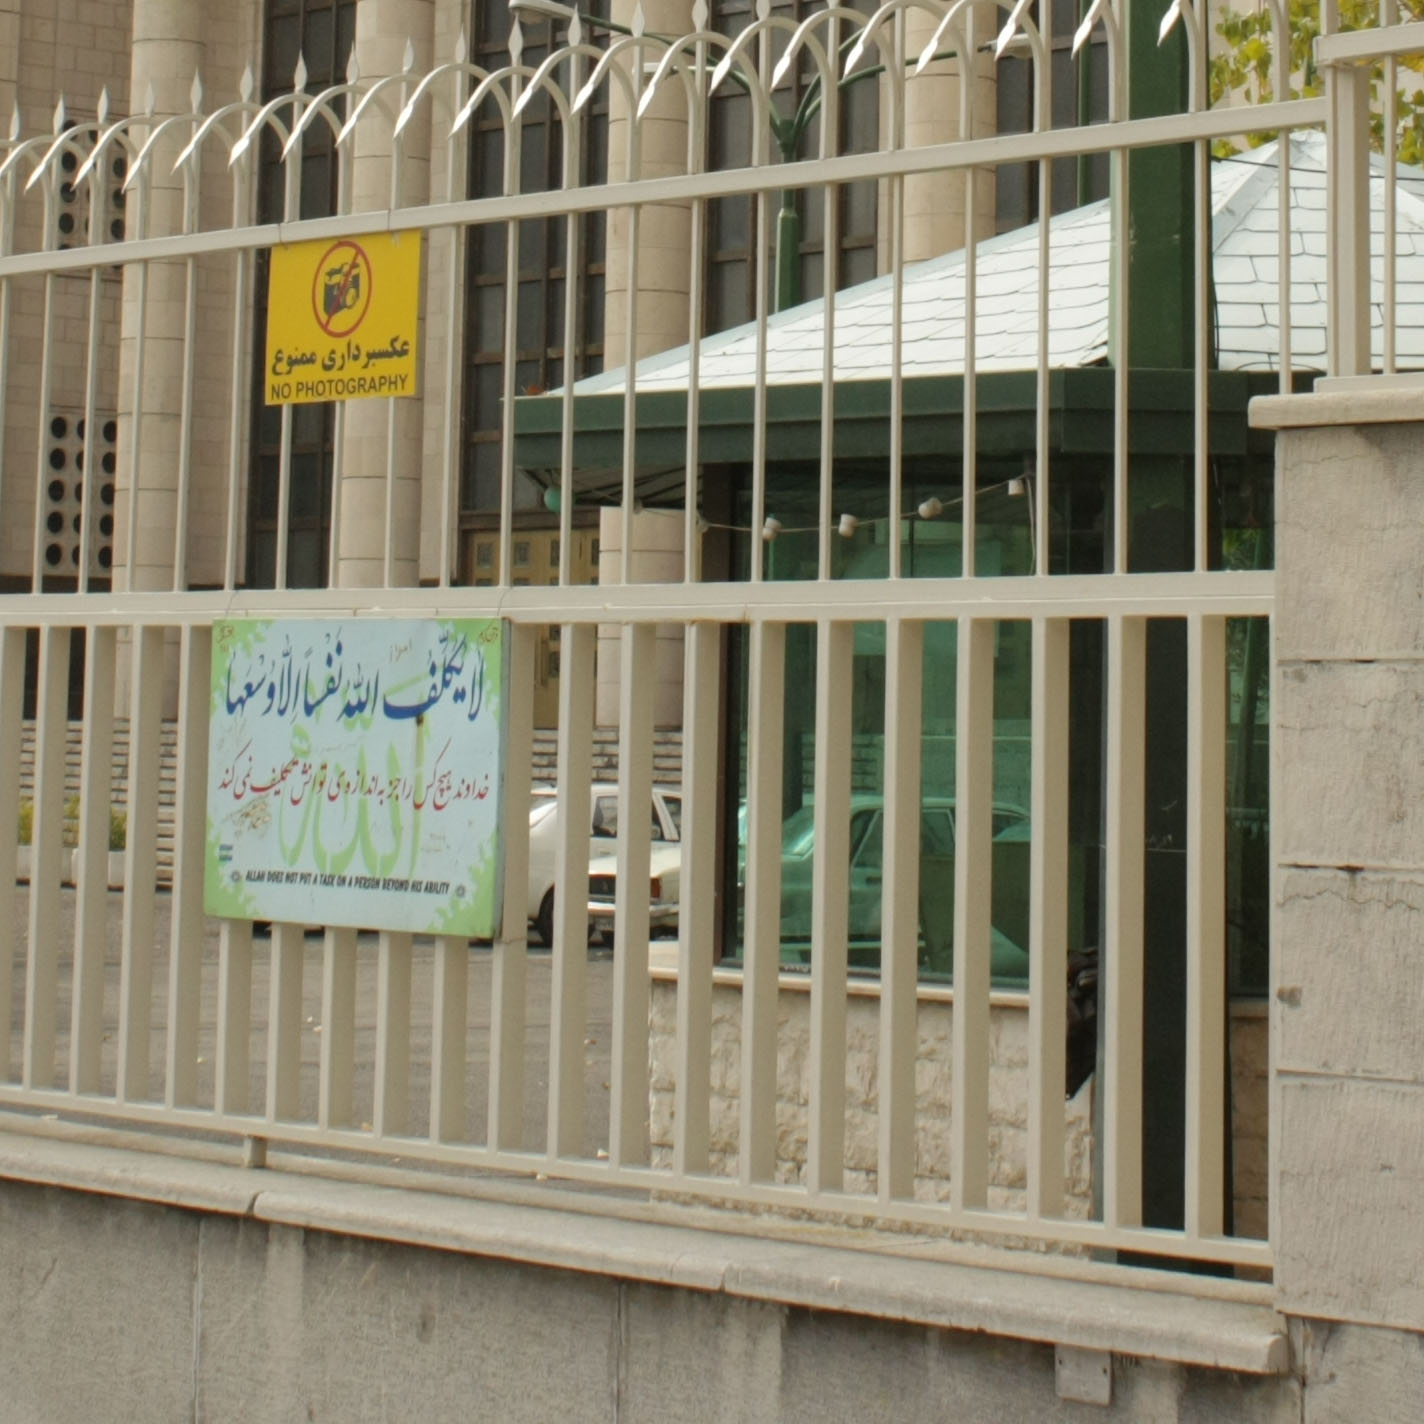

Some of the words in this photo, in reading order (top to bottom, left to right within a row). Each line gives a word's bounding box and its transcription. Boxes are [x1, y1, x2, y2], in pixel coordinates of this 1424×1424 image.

[271, 346, 317, 375] ممنوع
[271, 383, 292, 401] NO
[295, 374, 409, 399] PHOTOGRAPHY
[249, 755, 299, 796] تکلیف
[290, 760, 327, 806] توانش
[413, 736, 453, 810] کس
[453, 773, 489, 800] خداوند
[387, 777, 401, 802] جز
[402, 777, 413, 800] را
[433, 770, 452, 811] هیچ
[245, 870, 266, 883] ALLAH
[266, 871, 284, 884] DOES
[284, 871, 298, 885] NOT
[299, 872, 312, 885] PUT
[319, 873, 336, 887] TASK
[336, 874, 347, 888] ON
[353, 876, 381, 890] PERSON
[382, 878, 410, 892] BEYOND
[410, 880, 424, 893] HIS
[423, 880, 450, 895] ABILITY
